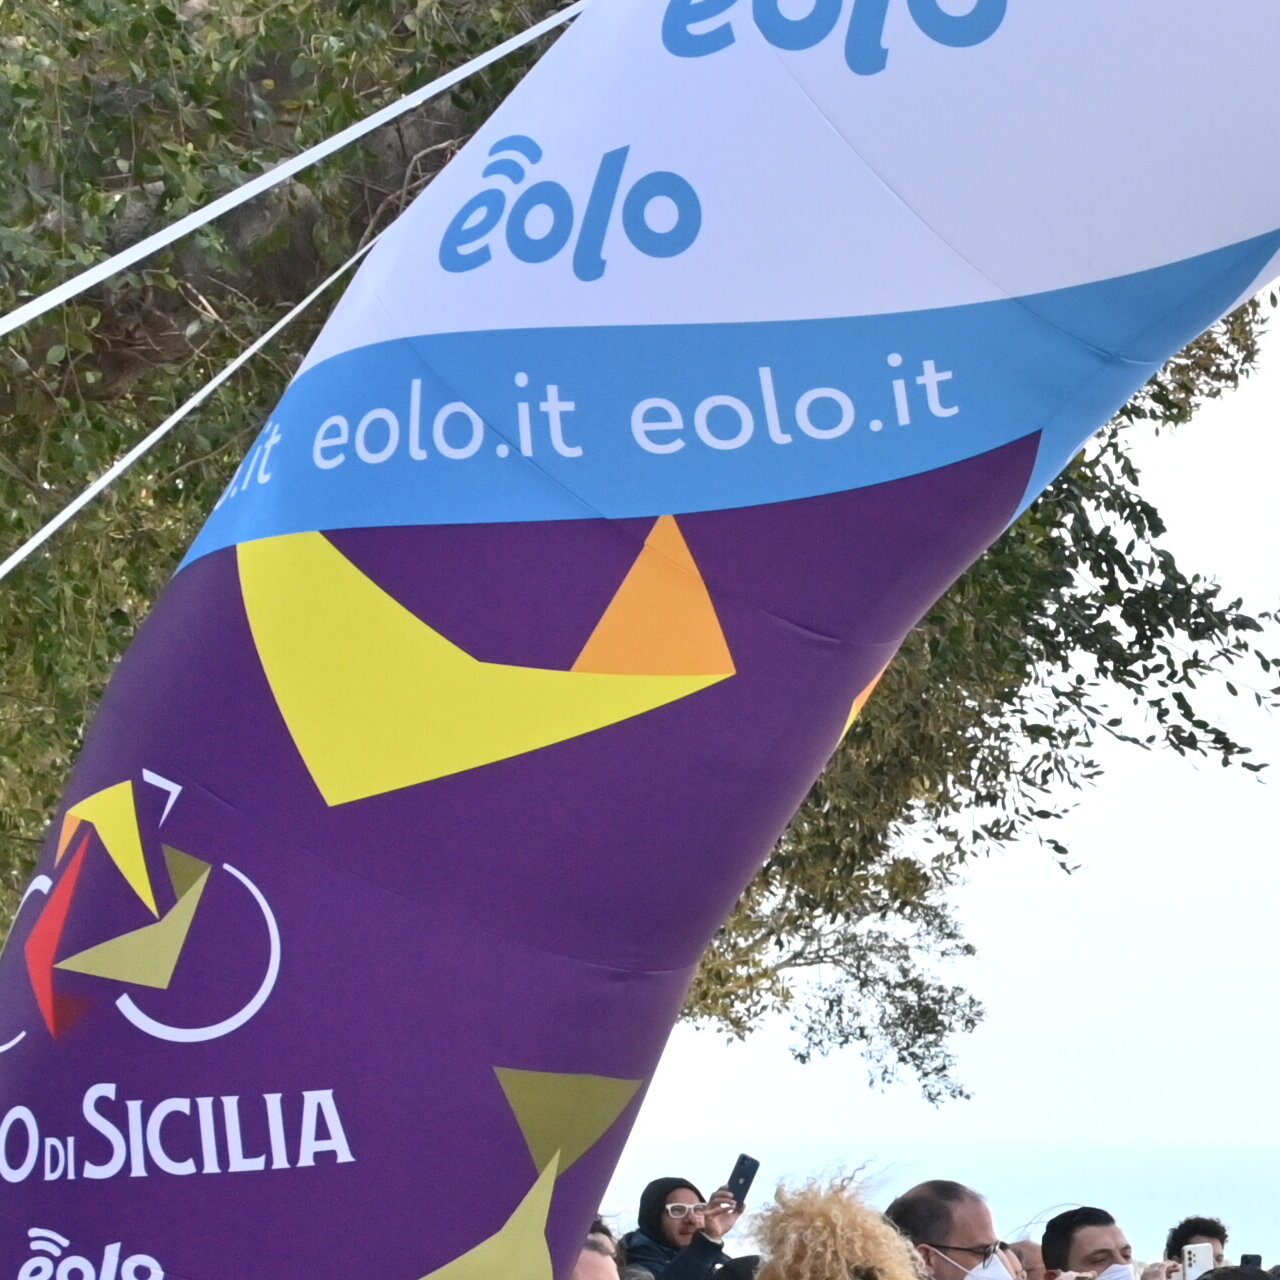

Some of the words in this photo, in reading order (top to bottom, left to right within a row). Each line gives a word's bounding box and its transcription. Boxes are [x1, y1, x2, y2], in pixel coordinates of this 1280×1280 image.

[438, 140, 703, 282] eolo
[312, 372, 583, 471] eolo.it
[630, 353, 959, 455] eolo.it
[44, 1137, 76, 1180] DI
[82, 1083, 356, 1181] SICILIA
